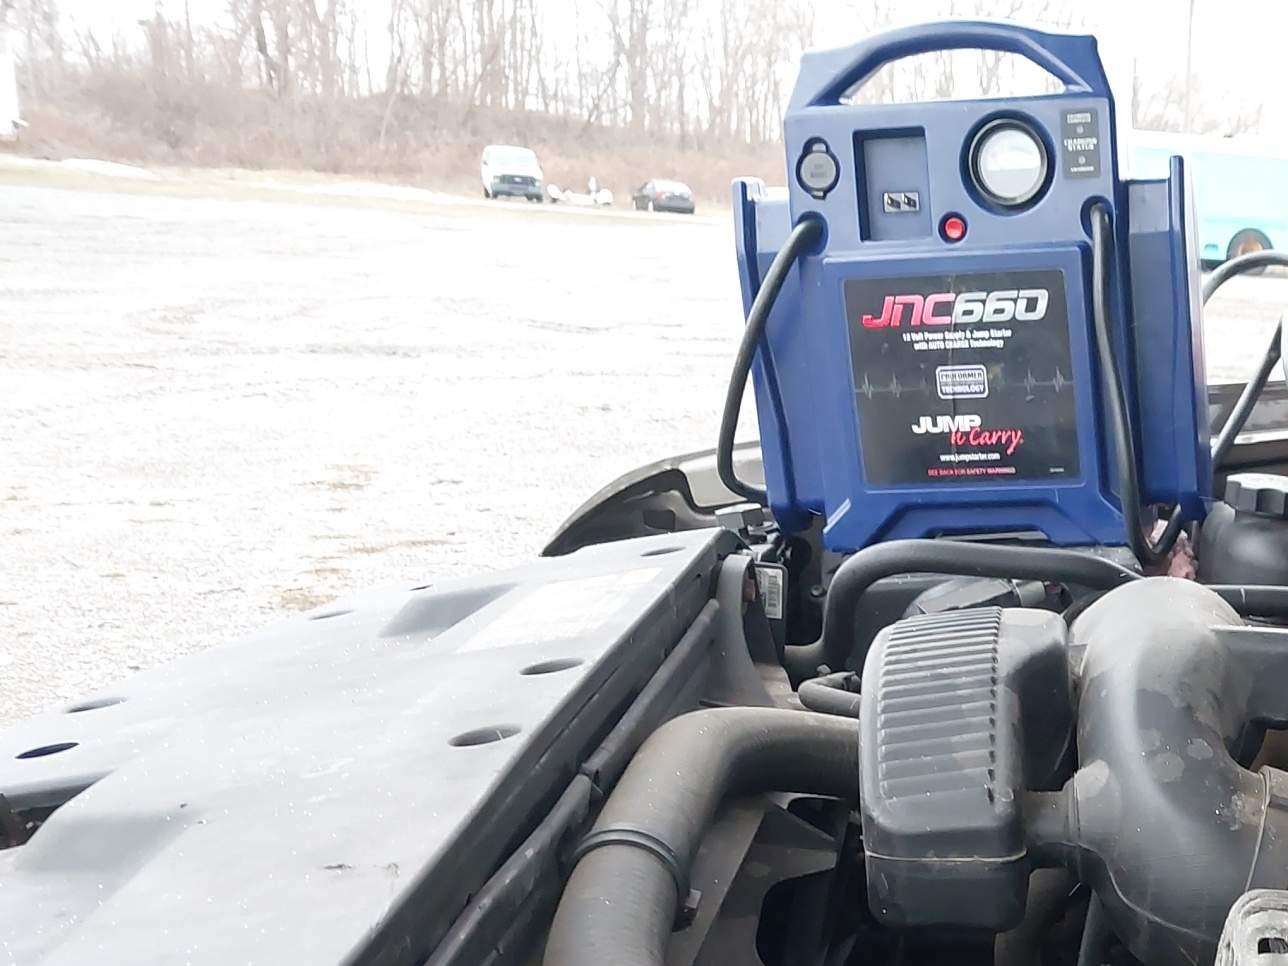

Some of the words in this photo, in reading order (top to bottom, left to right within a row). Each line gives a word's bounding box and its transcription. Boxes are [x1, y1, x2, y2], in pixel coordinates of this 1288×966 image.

[862, 288, 1049, 329] JNC660
[911, 414, 982, 434] JUMP
[969, 427, 1022, 455] Carry
